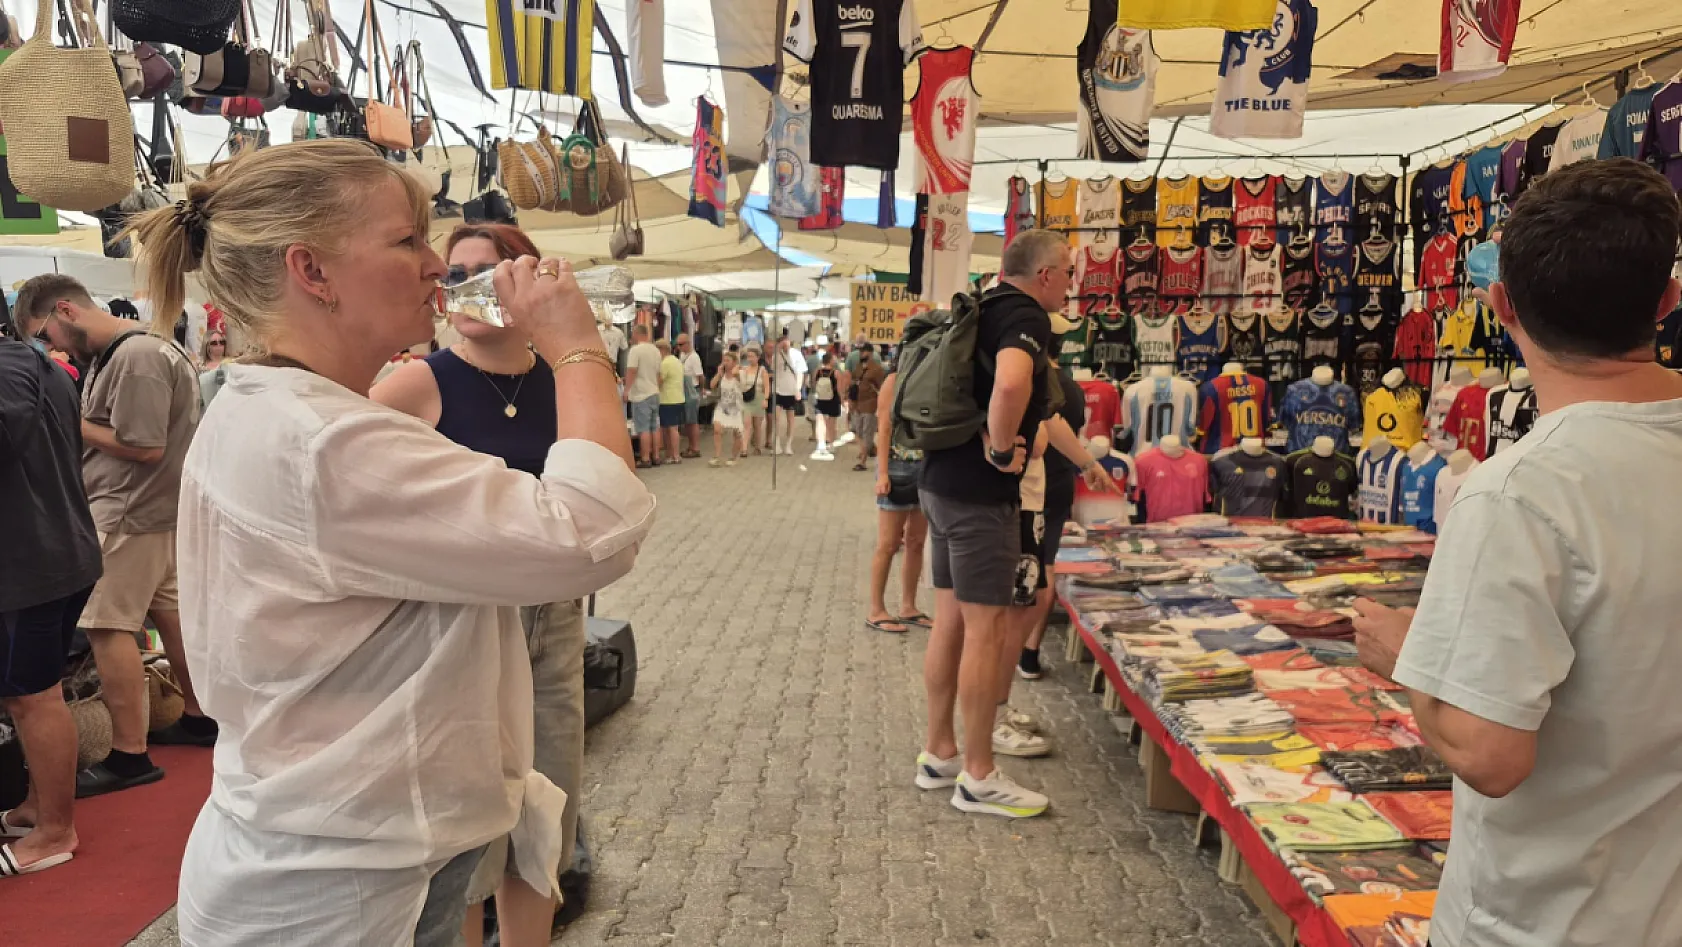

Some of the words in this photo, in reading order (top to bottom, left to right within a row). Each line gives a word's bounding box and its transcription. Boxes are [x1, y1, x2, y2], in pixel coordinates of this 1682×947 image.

[838, 4, 875, 20] beko
[841, 31, 871, 98] 7
[1271, 49, 1291, 65] CLUB
[832, 104, 884, 120] QUARESMA
[1252, 98, 1291, 111] BLUE
[1084, 209, 1115, 224] LAKERS
[1236, 205, 1274, 225] ROCKETS
[931, 217, 961, 252] 22
[856, 285, 886, 301] ANY
[859, 306, 867, 323] 3
[872, 308, 895, 323] FOR
[869, 327, 895, 339] FOR
[1362, 369, 1376, 382] 30
[1227, 385, 1256, 398] MESSI
[1145, 402, 1174, 443] 10
[1227, 399, 1259, 439] 10
